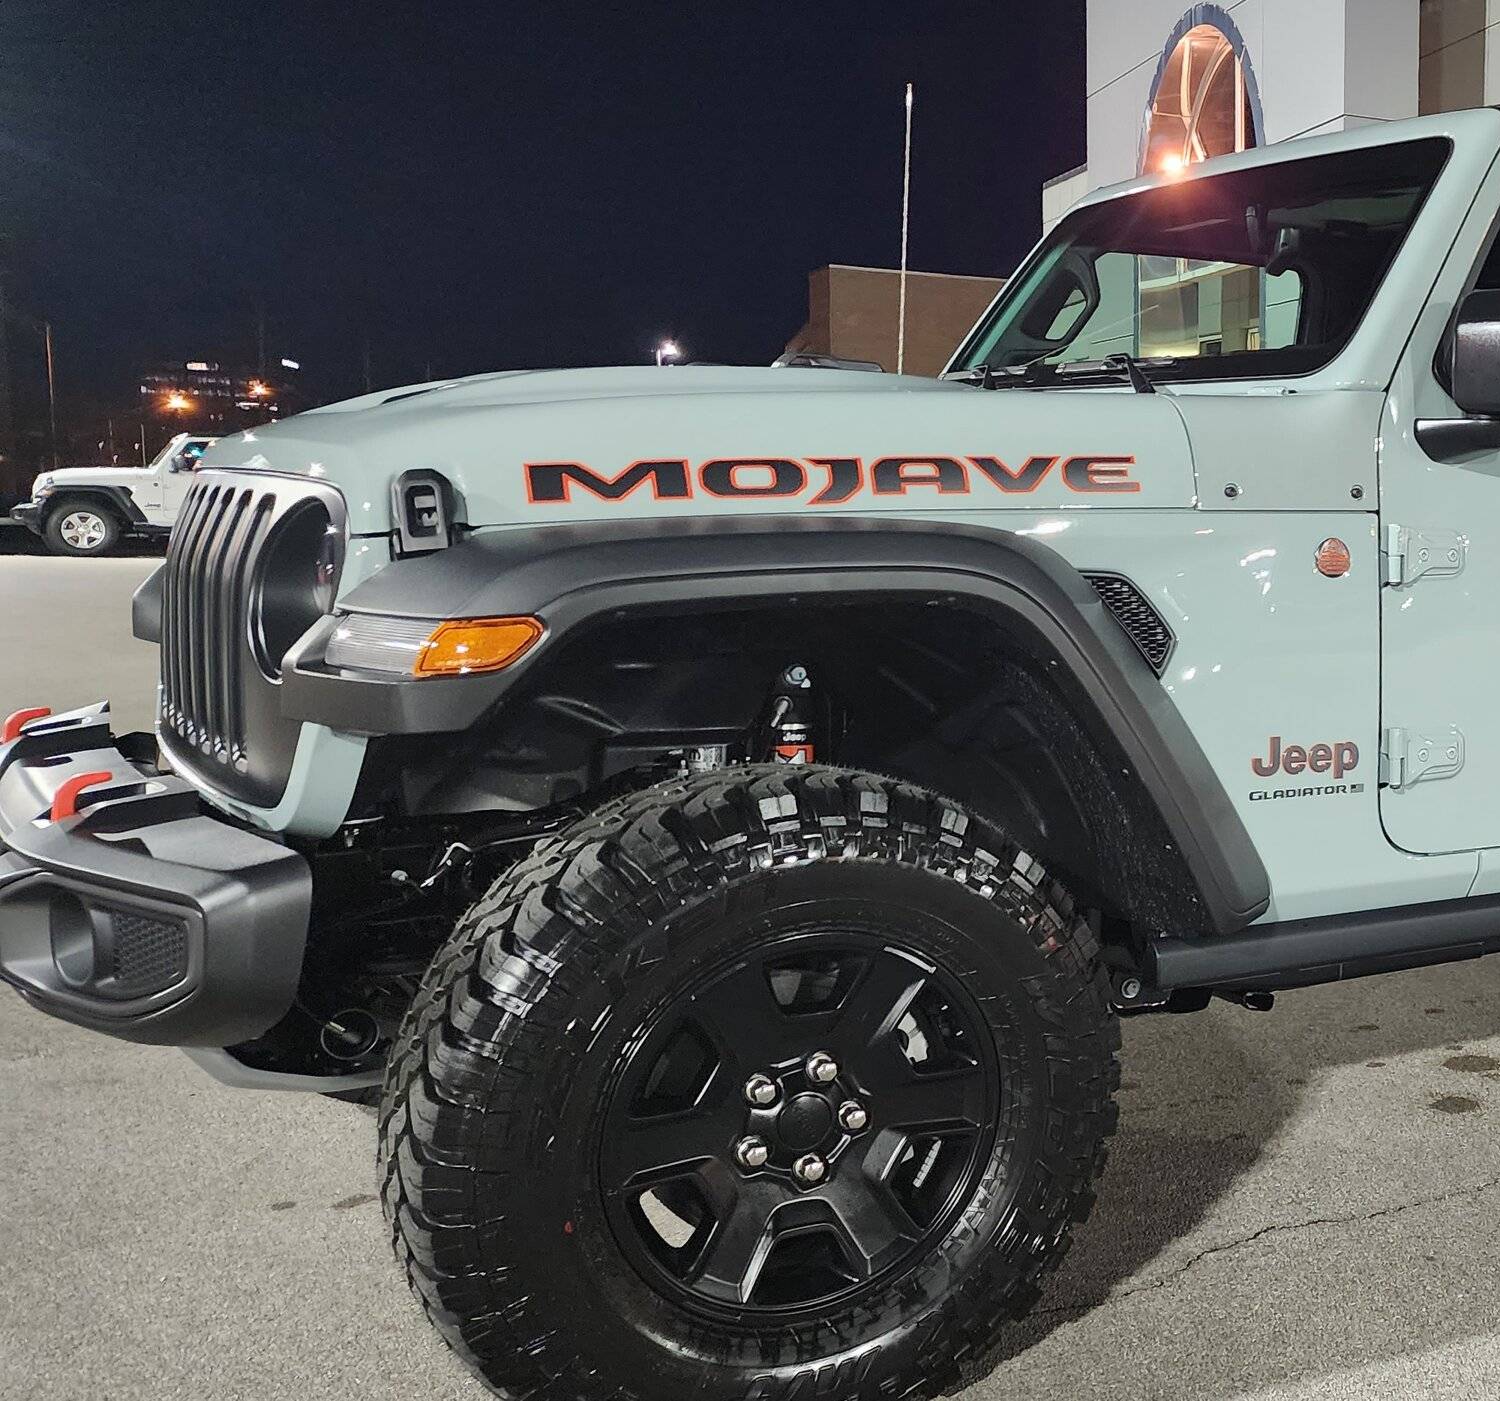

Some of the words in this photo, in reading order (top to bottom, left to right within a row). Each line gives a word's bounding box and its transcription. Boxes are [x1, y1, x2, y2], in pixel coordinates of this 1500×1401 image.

[523, 455, 1141, 504] MOJAVE
[1251, 736, 1360, 779] Jeep
[1248, 784, 1348, 801] GLADIATOR
